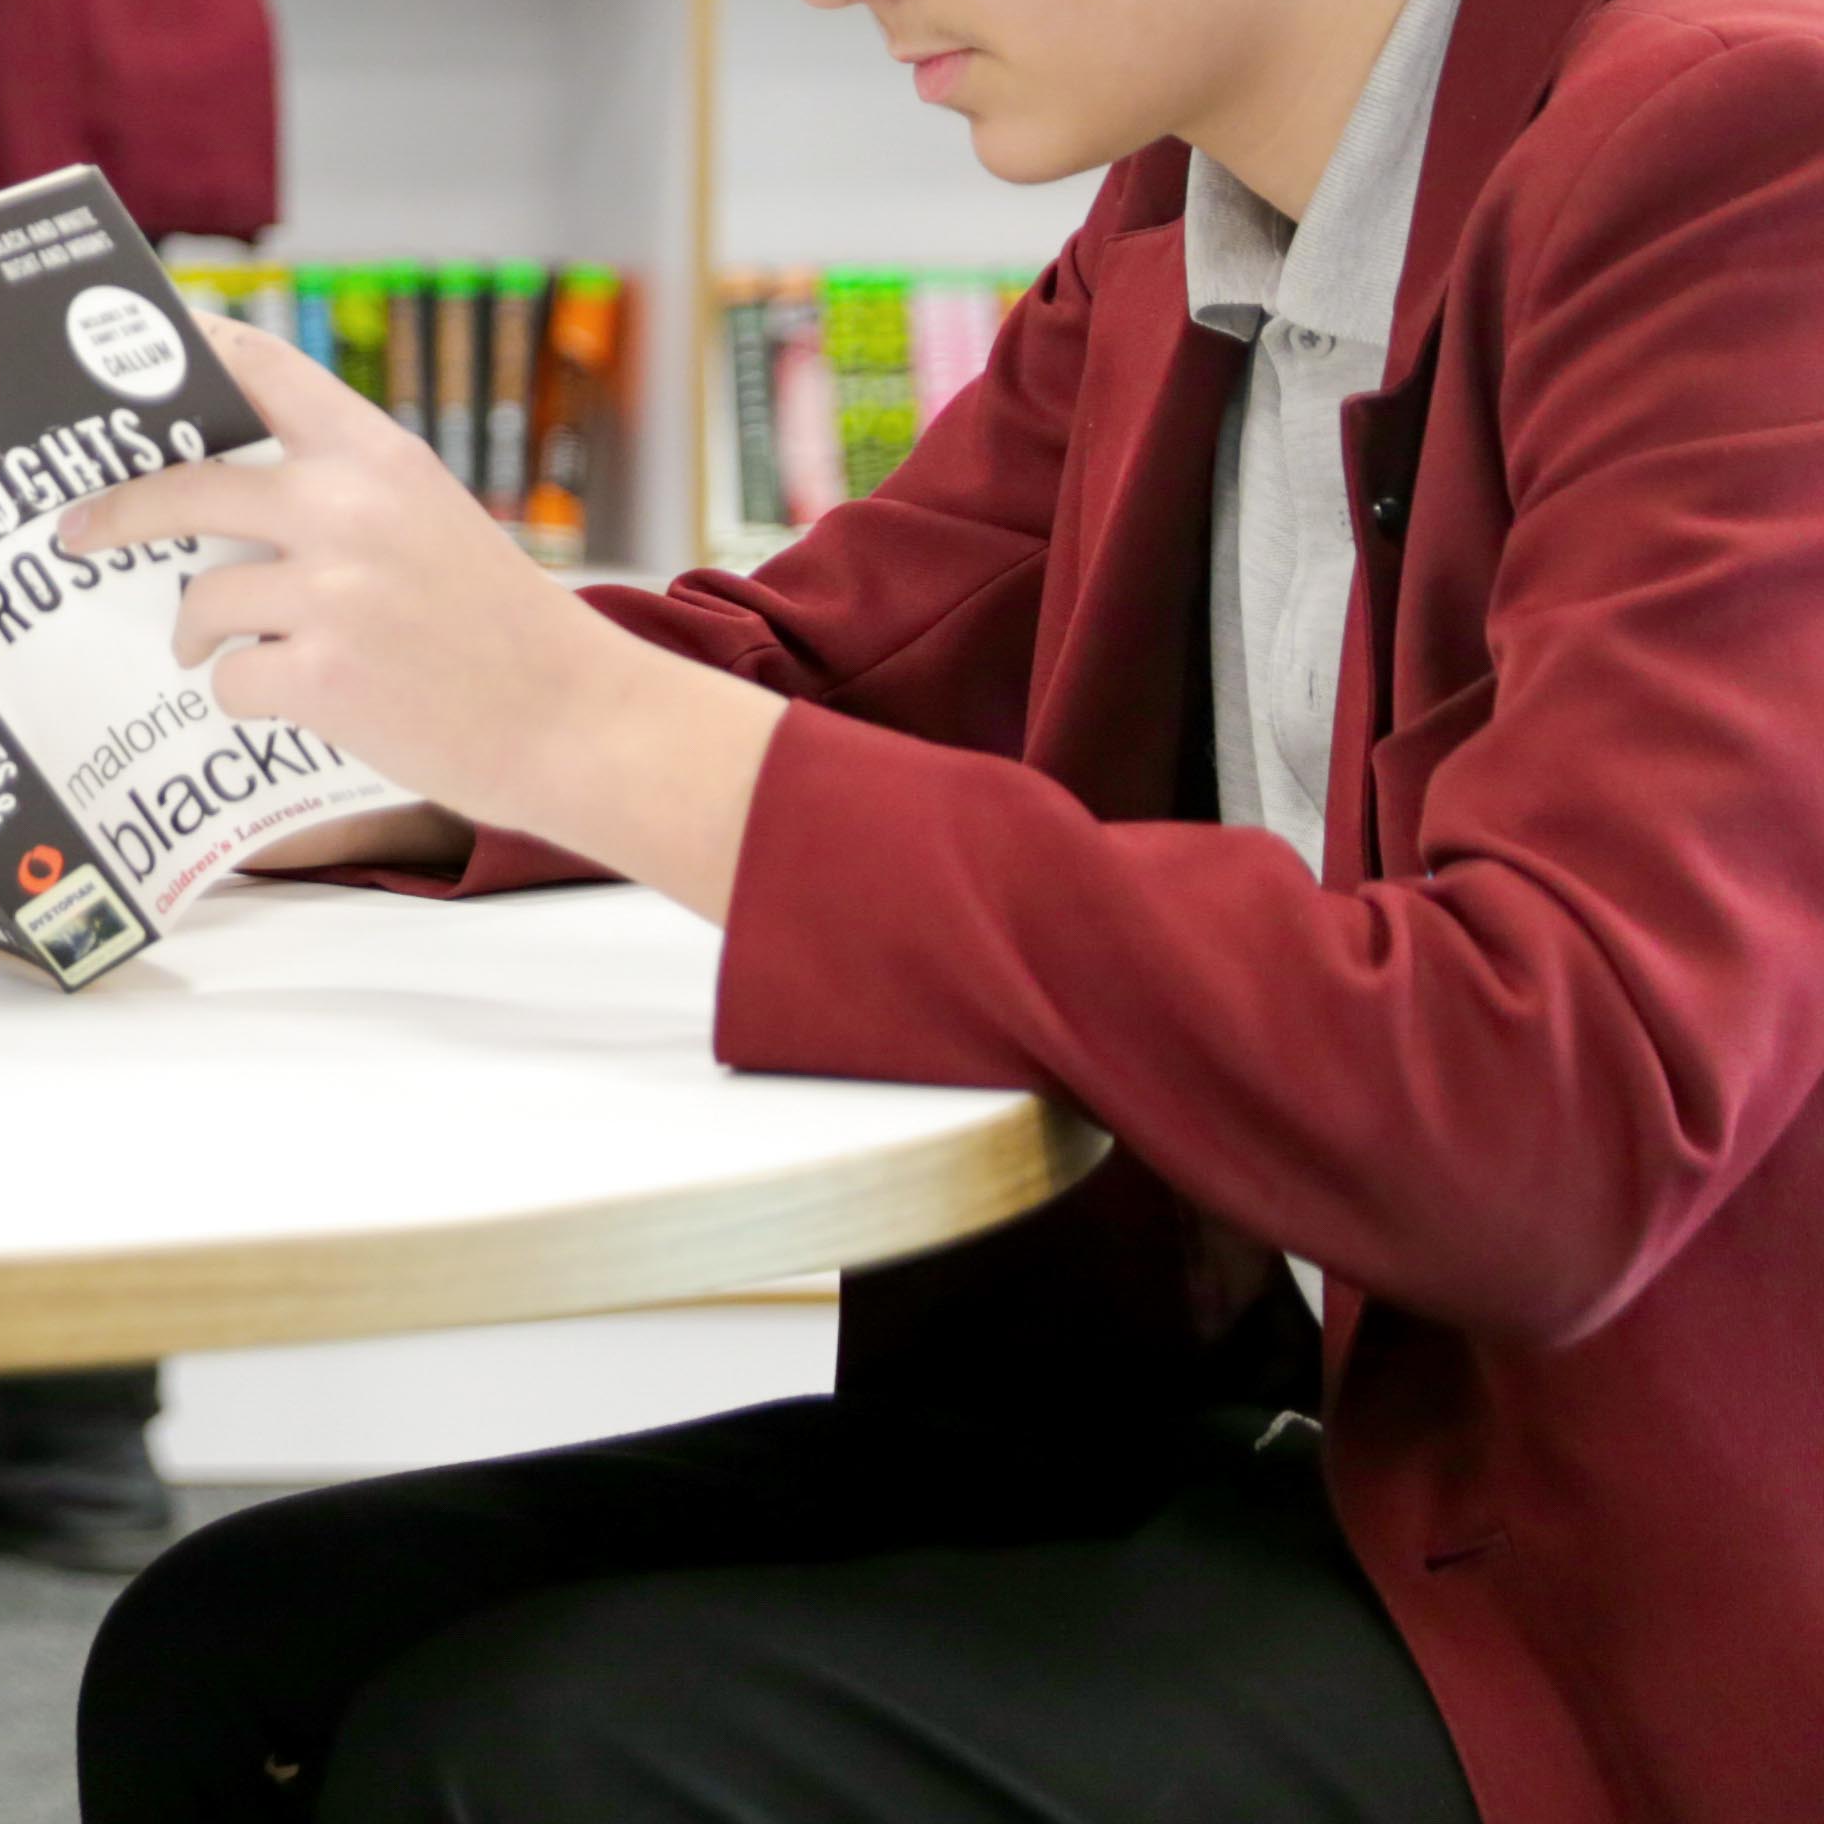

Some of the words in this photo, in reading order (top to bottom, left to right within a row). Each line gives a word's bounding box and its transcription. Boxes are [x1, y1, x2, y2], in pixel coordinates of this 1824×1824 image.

[102, 340, 175, 377] CALLUM
[66, 688, 209, 810] malorie
[156, 838, 232, 914] Children's
[233, 795, 323, 842] Laureate
